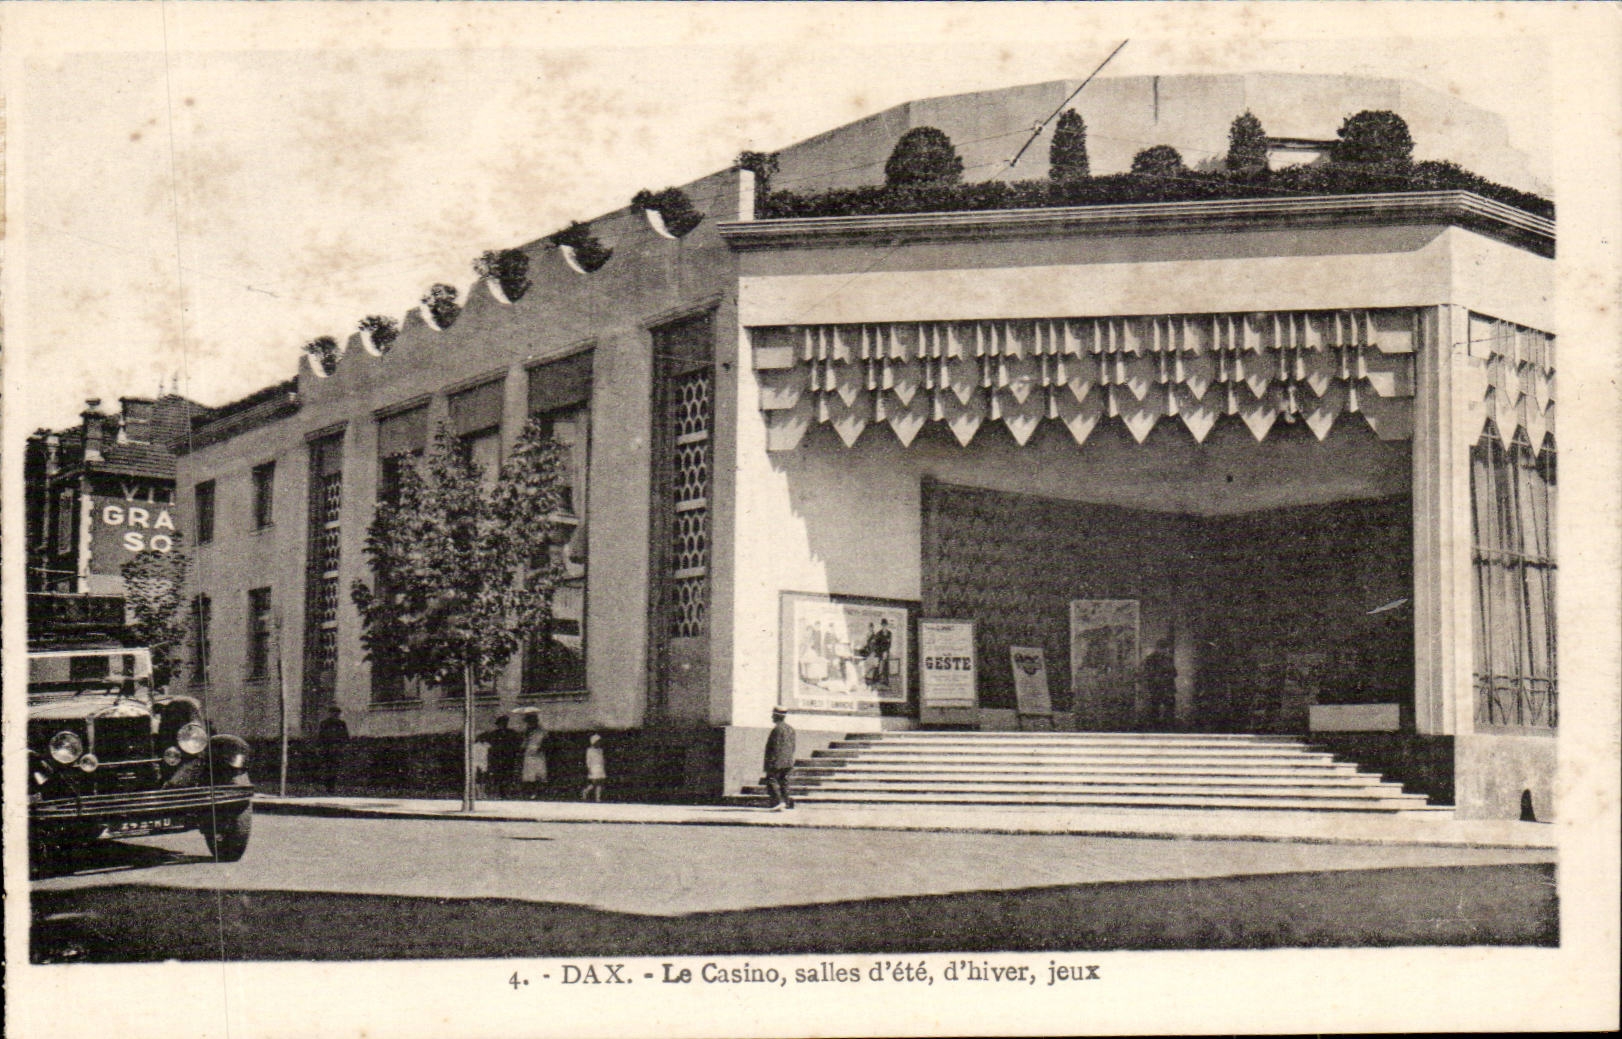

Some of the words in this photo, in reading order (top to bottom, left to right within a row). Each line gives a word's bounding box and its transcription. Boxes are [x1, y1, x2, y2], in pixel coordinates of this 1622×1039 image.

[102, 505, 175, 530] GRA
[123, 532, 173, 553] SO
[925, 656, 972, 671] GESTE
